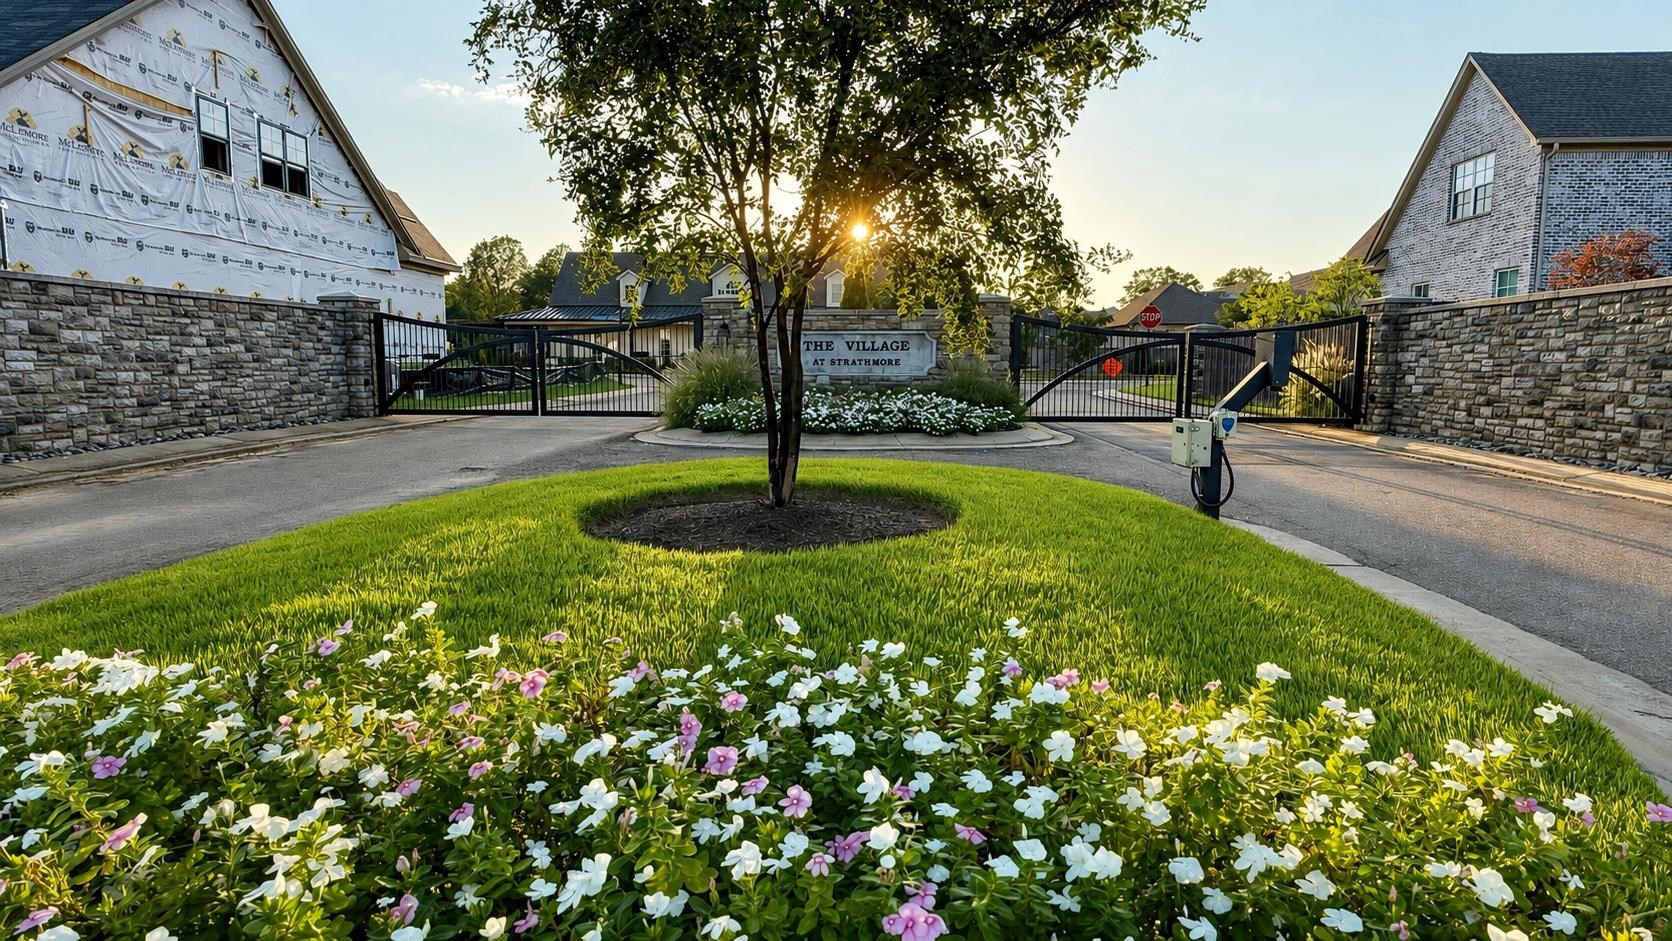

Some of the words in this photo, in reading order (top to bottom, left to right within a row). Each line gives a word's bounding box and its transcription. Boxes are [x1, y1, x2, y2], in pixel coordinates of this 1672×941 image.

[1141, 312, 1161, 321] STOP
[803, 340, 834, 351] THE
[845, 340, 910, 351] VILLAGE
[812, 358, 825, 366] AT
[830, 358, 901, 366] STRATHMORE
